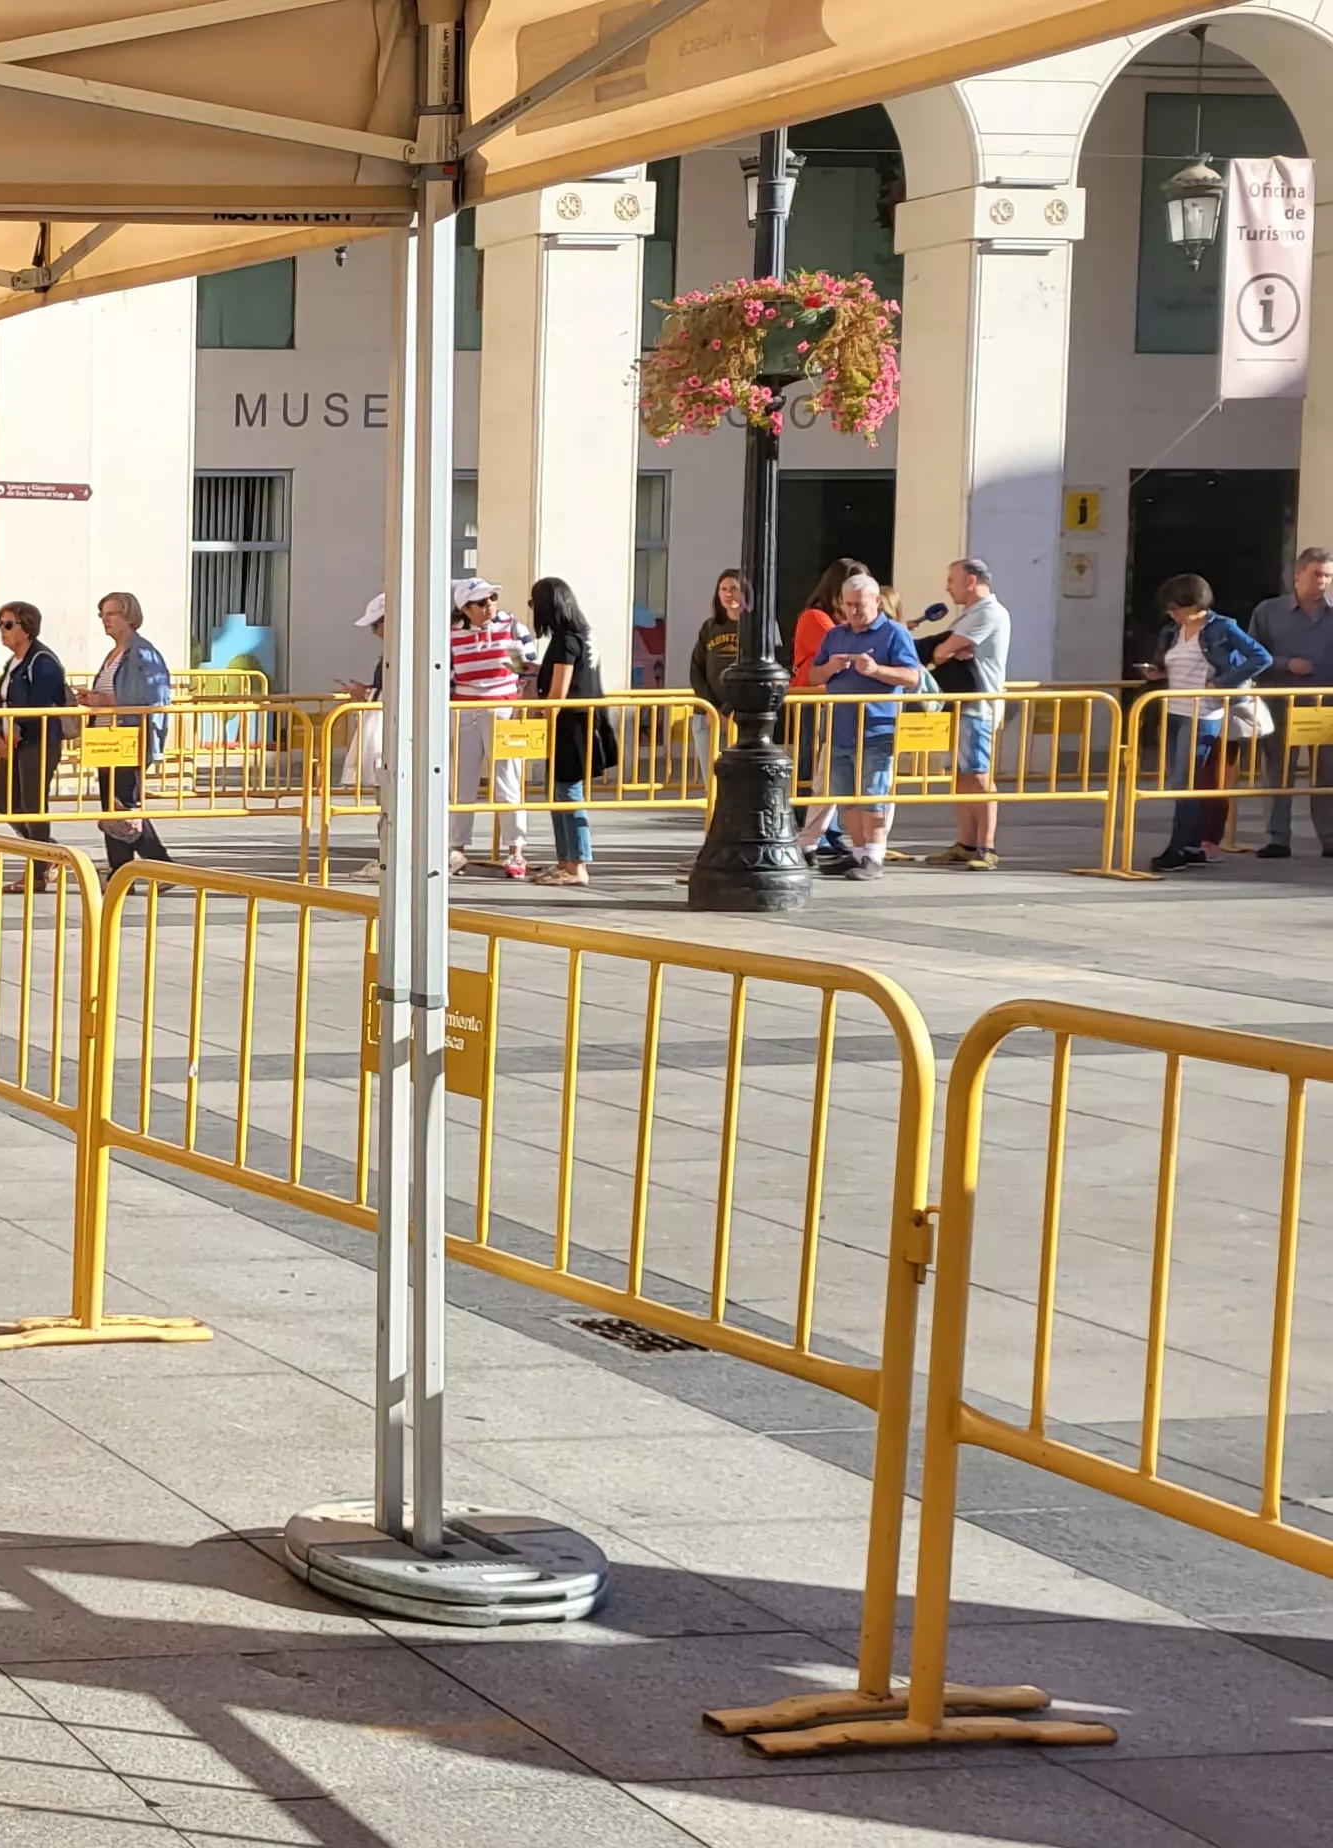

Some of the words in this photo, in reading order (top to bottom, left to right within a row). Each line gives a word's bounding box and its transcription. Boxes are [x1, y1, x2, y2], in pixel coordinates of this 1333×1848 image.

[1248, 182, 1306, 199] Oficina
[1284, 204, 1306, 221] de
[1236, 225, 1306, 242] Turismo
[234, 392, 389, 428] MUSE
